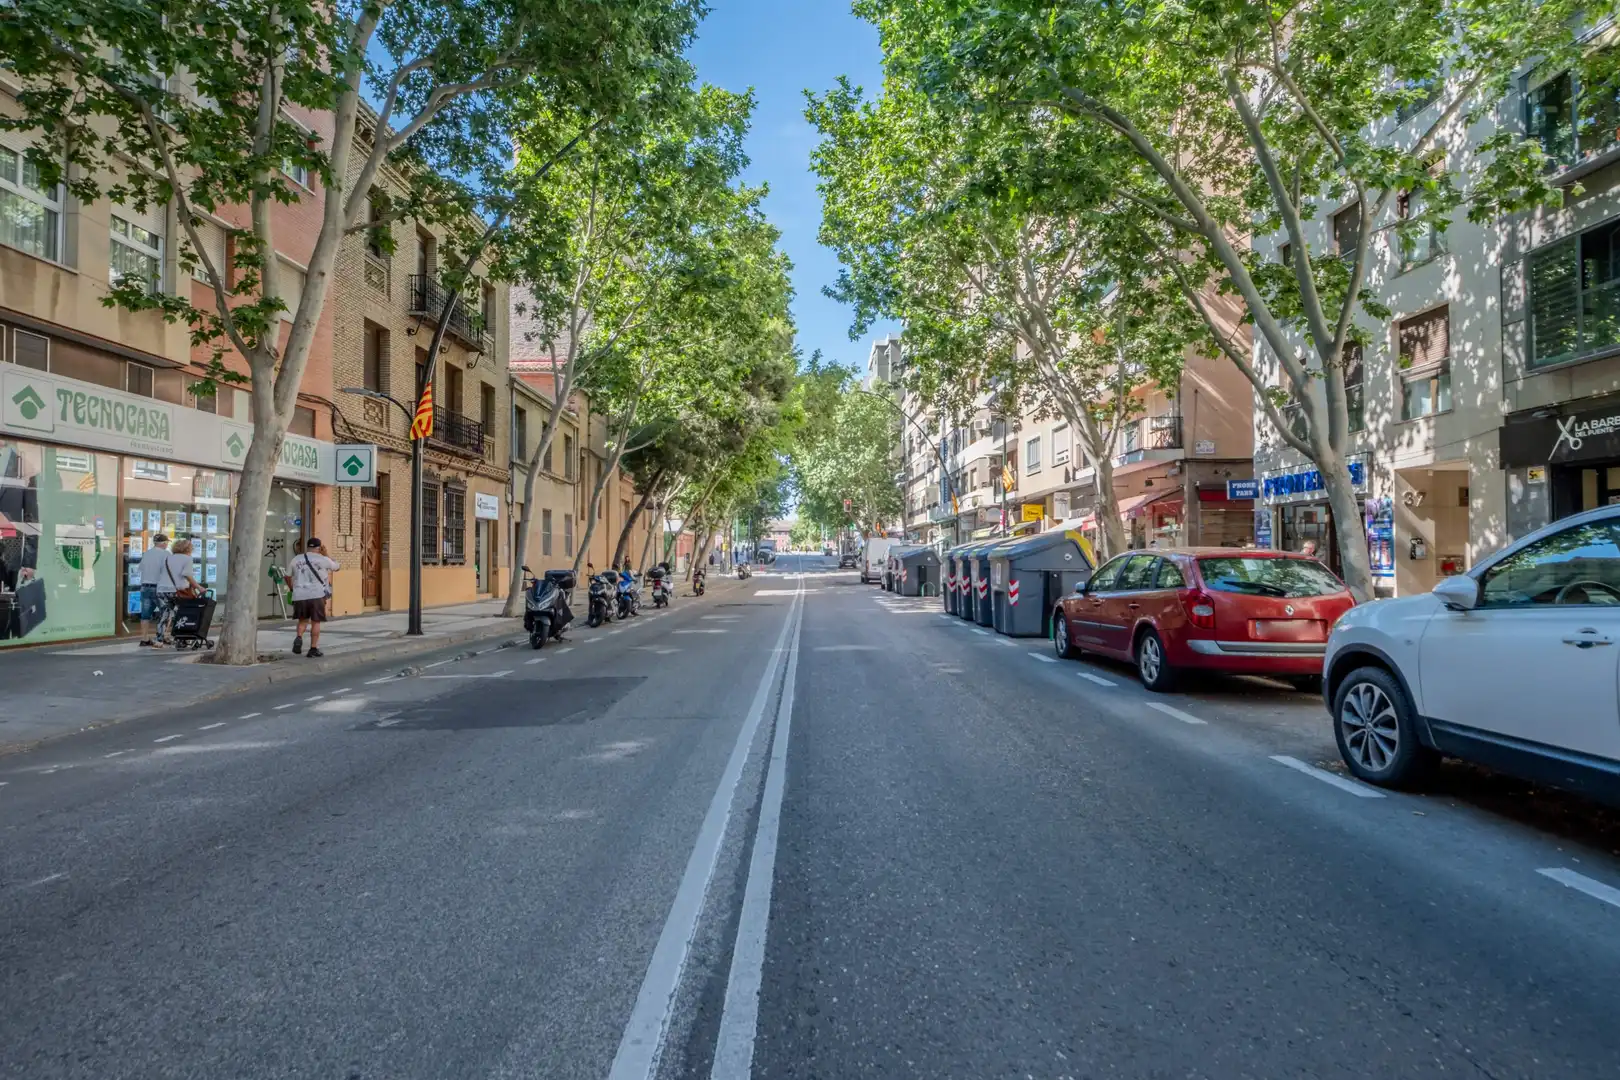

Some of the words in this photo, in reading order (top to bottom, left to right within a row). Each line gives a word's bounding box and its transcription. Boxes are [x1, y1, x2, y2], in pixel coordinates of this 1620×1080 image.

[56, 388, 170, 441] TECNOCASA
[1575, 422, 1590, 432] LA
[1588, 427, 1614, 436] PUENTE
[1403, 491, 1427, 507] 37
